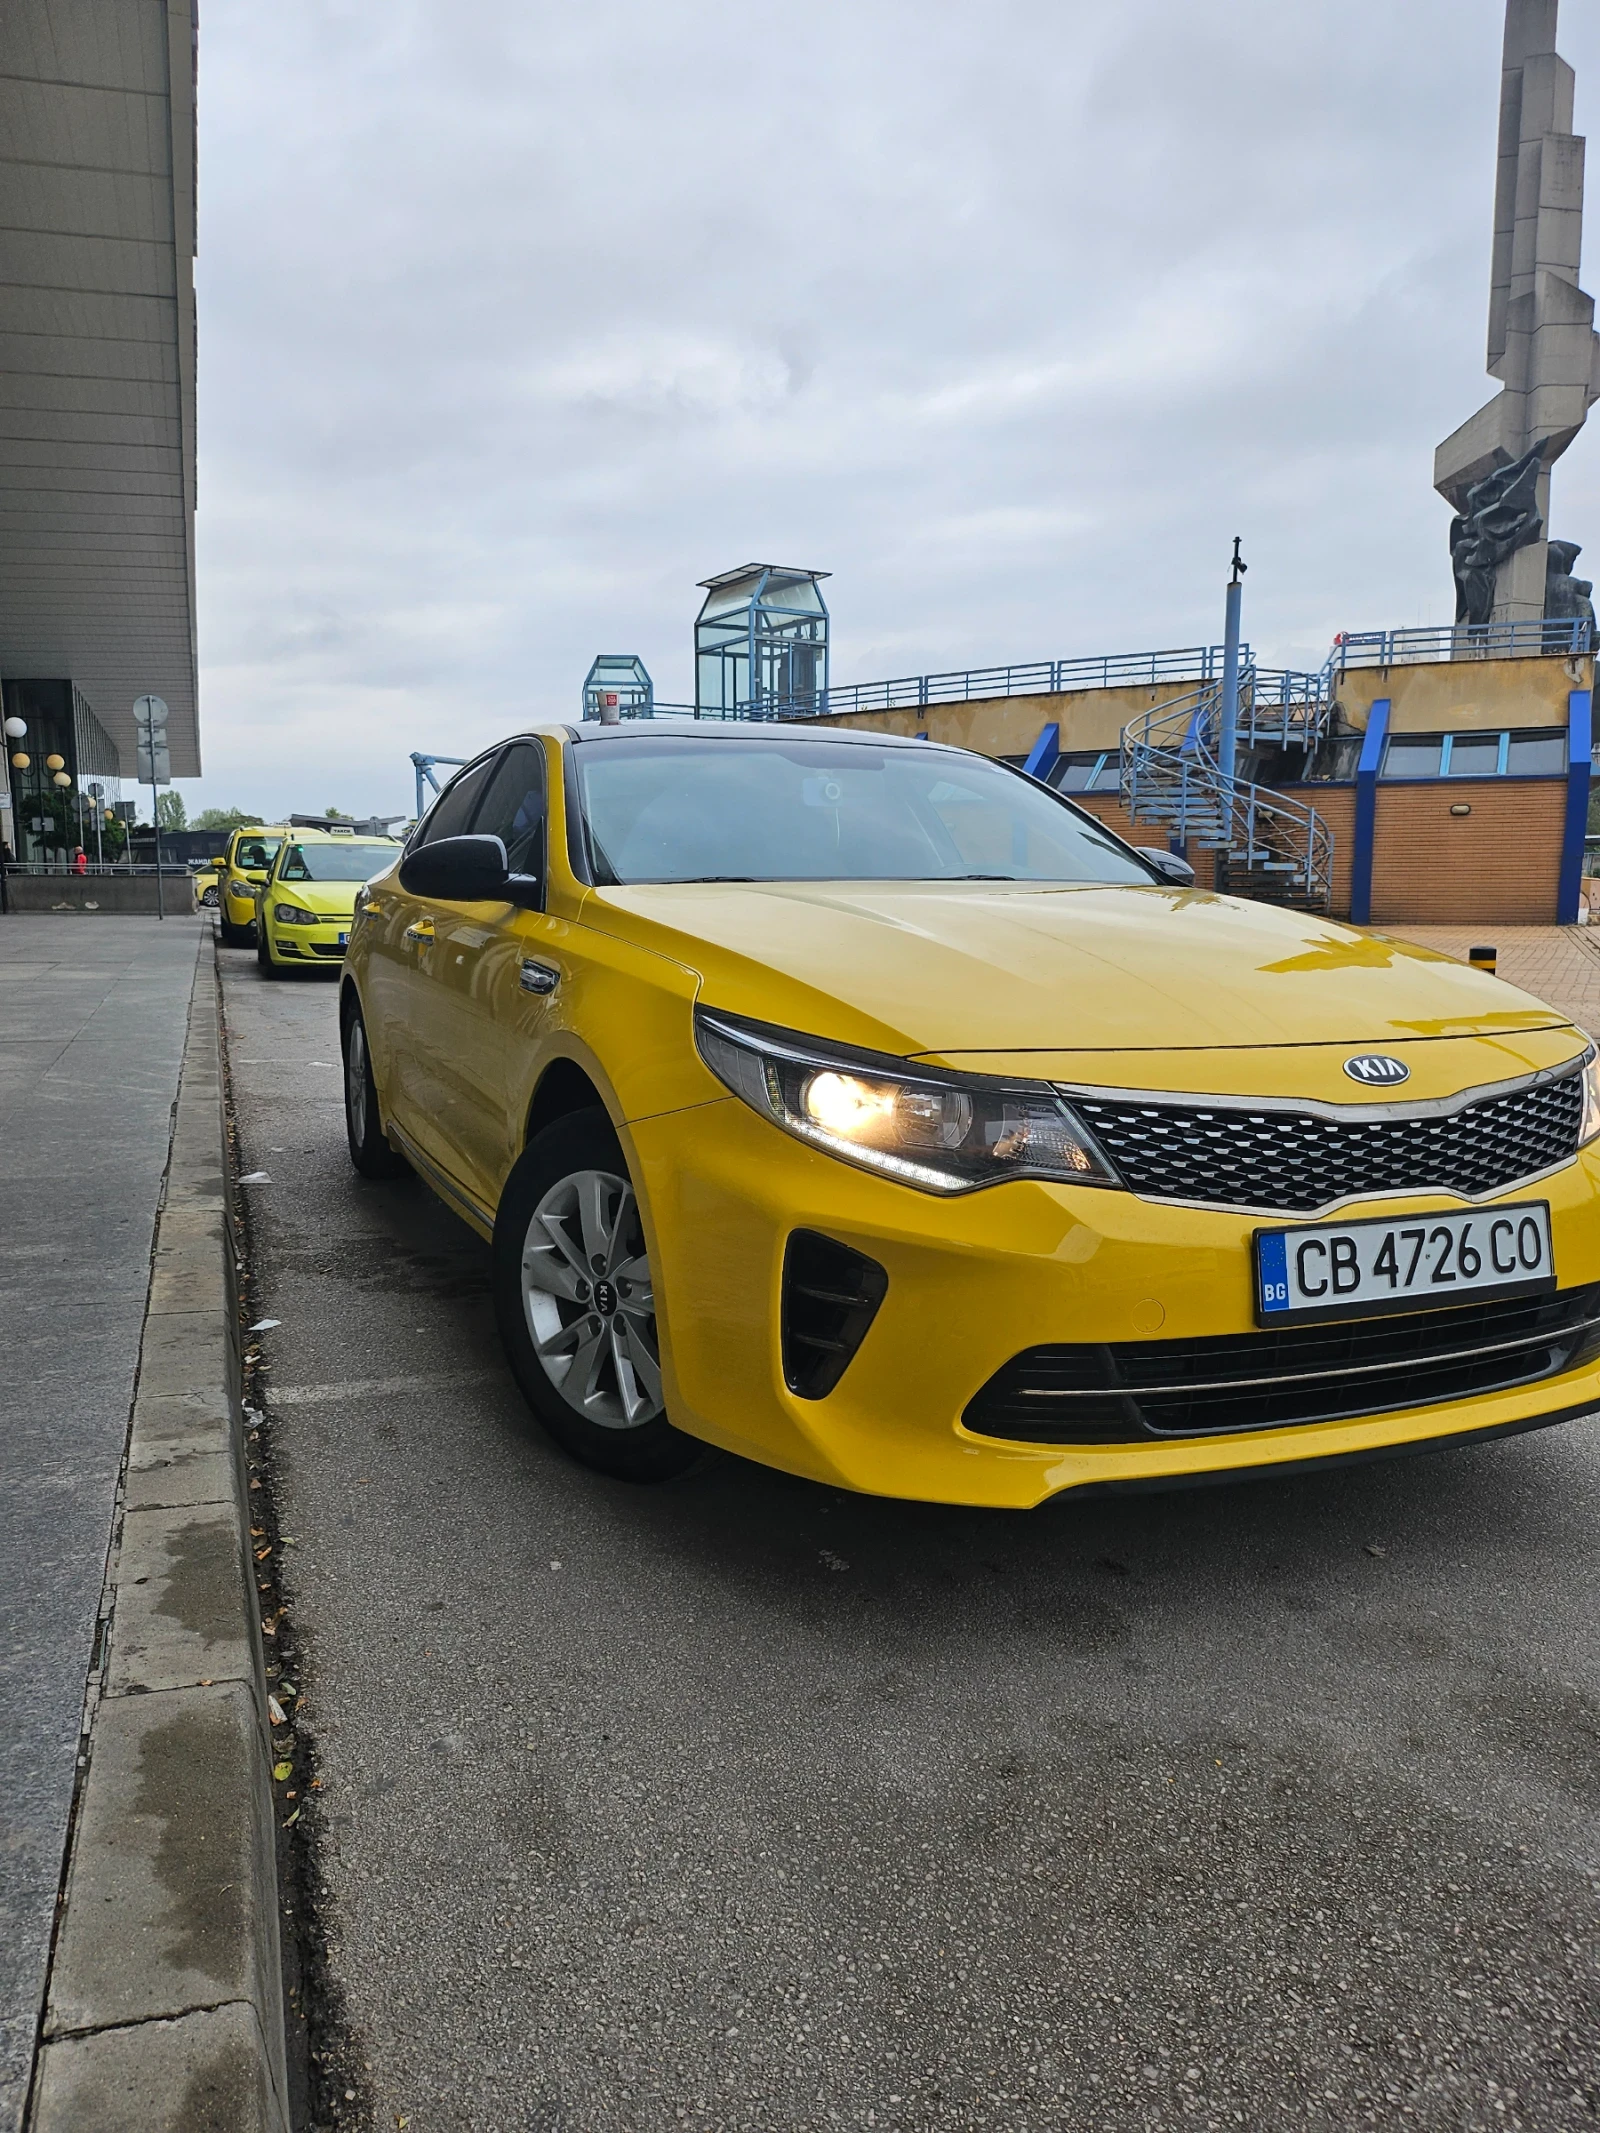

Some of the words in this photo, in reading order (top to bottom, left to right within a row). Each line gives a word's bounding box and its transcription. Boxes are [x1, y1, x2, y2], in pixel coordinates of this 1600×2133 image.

[1352, 1059, 1405, 1077] KIA
[1297, 1236, 1360, 1297] CB
[1373, 1223, 1481, 1288] 4726
[1490, 1216, 1542, 1273] CO
[600, 1285, 608, 1311] KIA
[1264, 1283, 1286, 1301] BG
